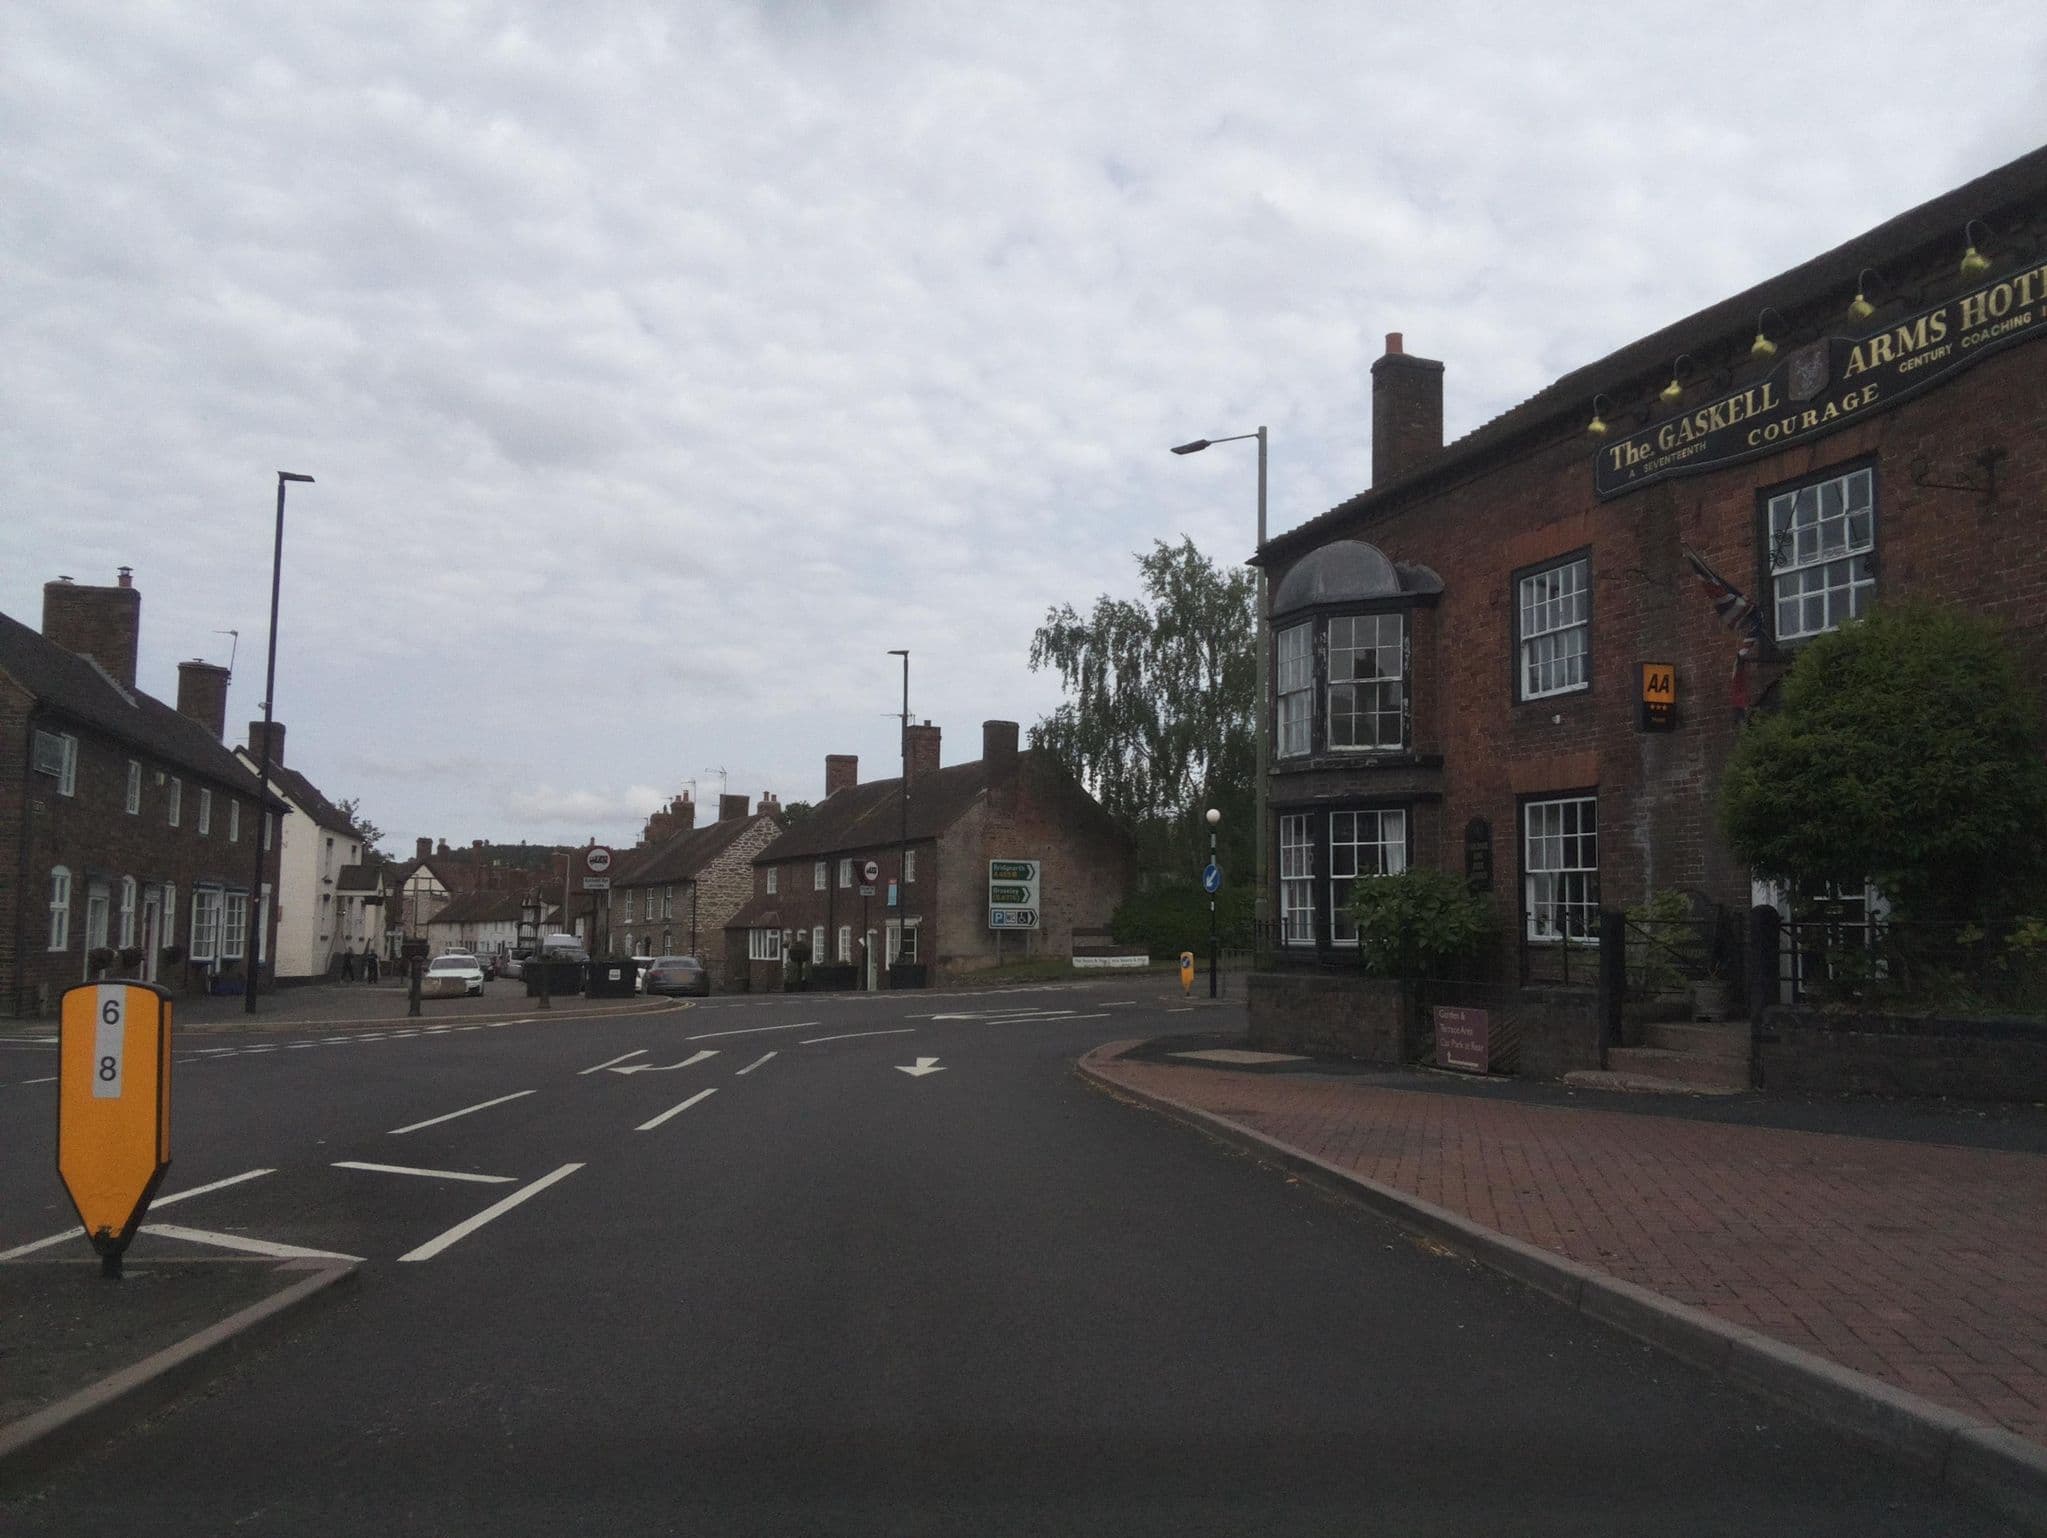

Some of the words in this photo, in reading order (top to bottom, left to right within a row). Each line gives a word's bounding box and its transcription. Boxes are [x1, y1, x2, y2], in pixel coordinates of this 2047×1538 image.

[1658, 382, 1780, 450] GASKELL
[1843, 308, 1947, 380] ARMS
[1643, 441, 1707, 473] SEVENTEENTH
[1899, 342, 1953, 374] CENTURY
[1961, 311, 2032, 348] COACHING
[1747, 382, 1880, 446] COURAGE
[1647, 673, 1670, 693] AA
[995, 912, 1003, 923] P
[102, 1000, 120, 1025] 6
[99, 1056, 117, 1081] 8
